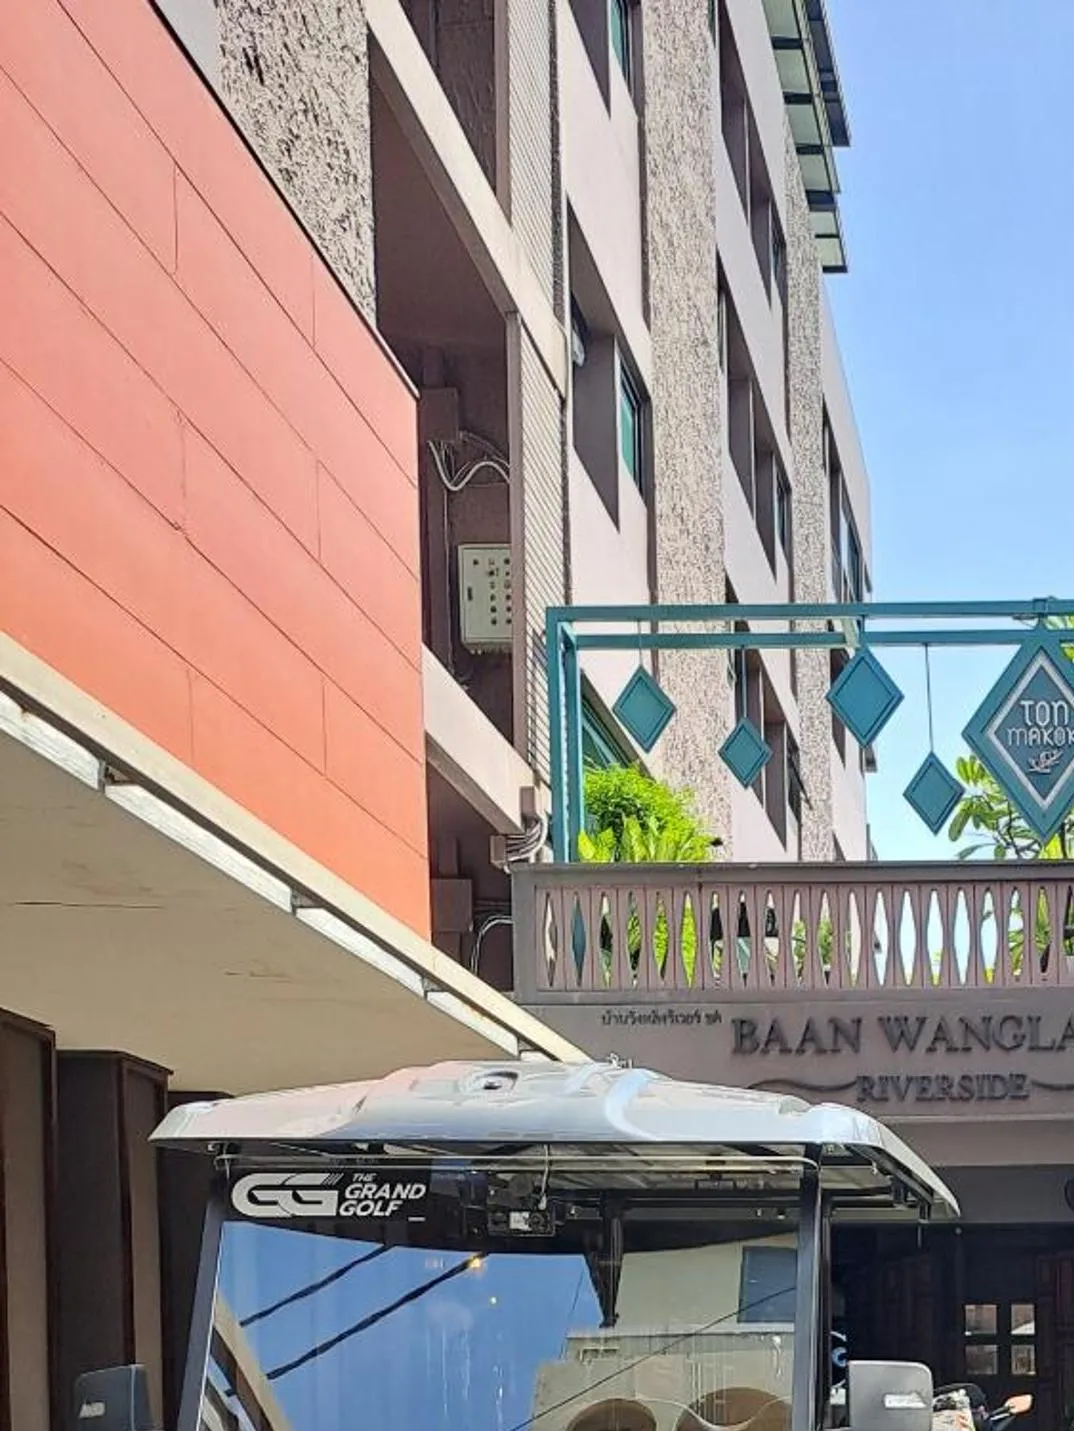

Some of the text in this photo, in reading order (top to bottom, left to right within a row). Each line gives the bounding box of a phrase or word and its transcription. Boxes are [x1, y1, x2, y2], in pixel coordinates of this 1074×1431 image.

[731, 1016, 863, 1056] BAAN
[856, 1073, 1030, 1102] RIVERSIDE
[352, 1173, 377, 1182] THE
[344, 1183, 426, 1200] GRAND
[339, 1201, 403, 1217] GOLF
